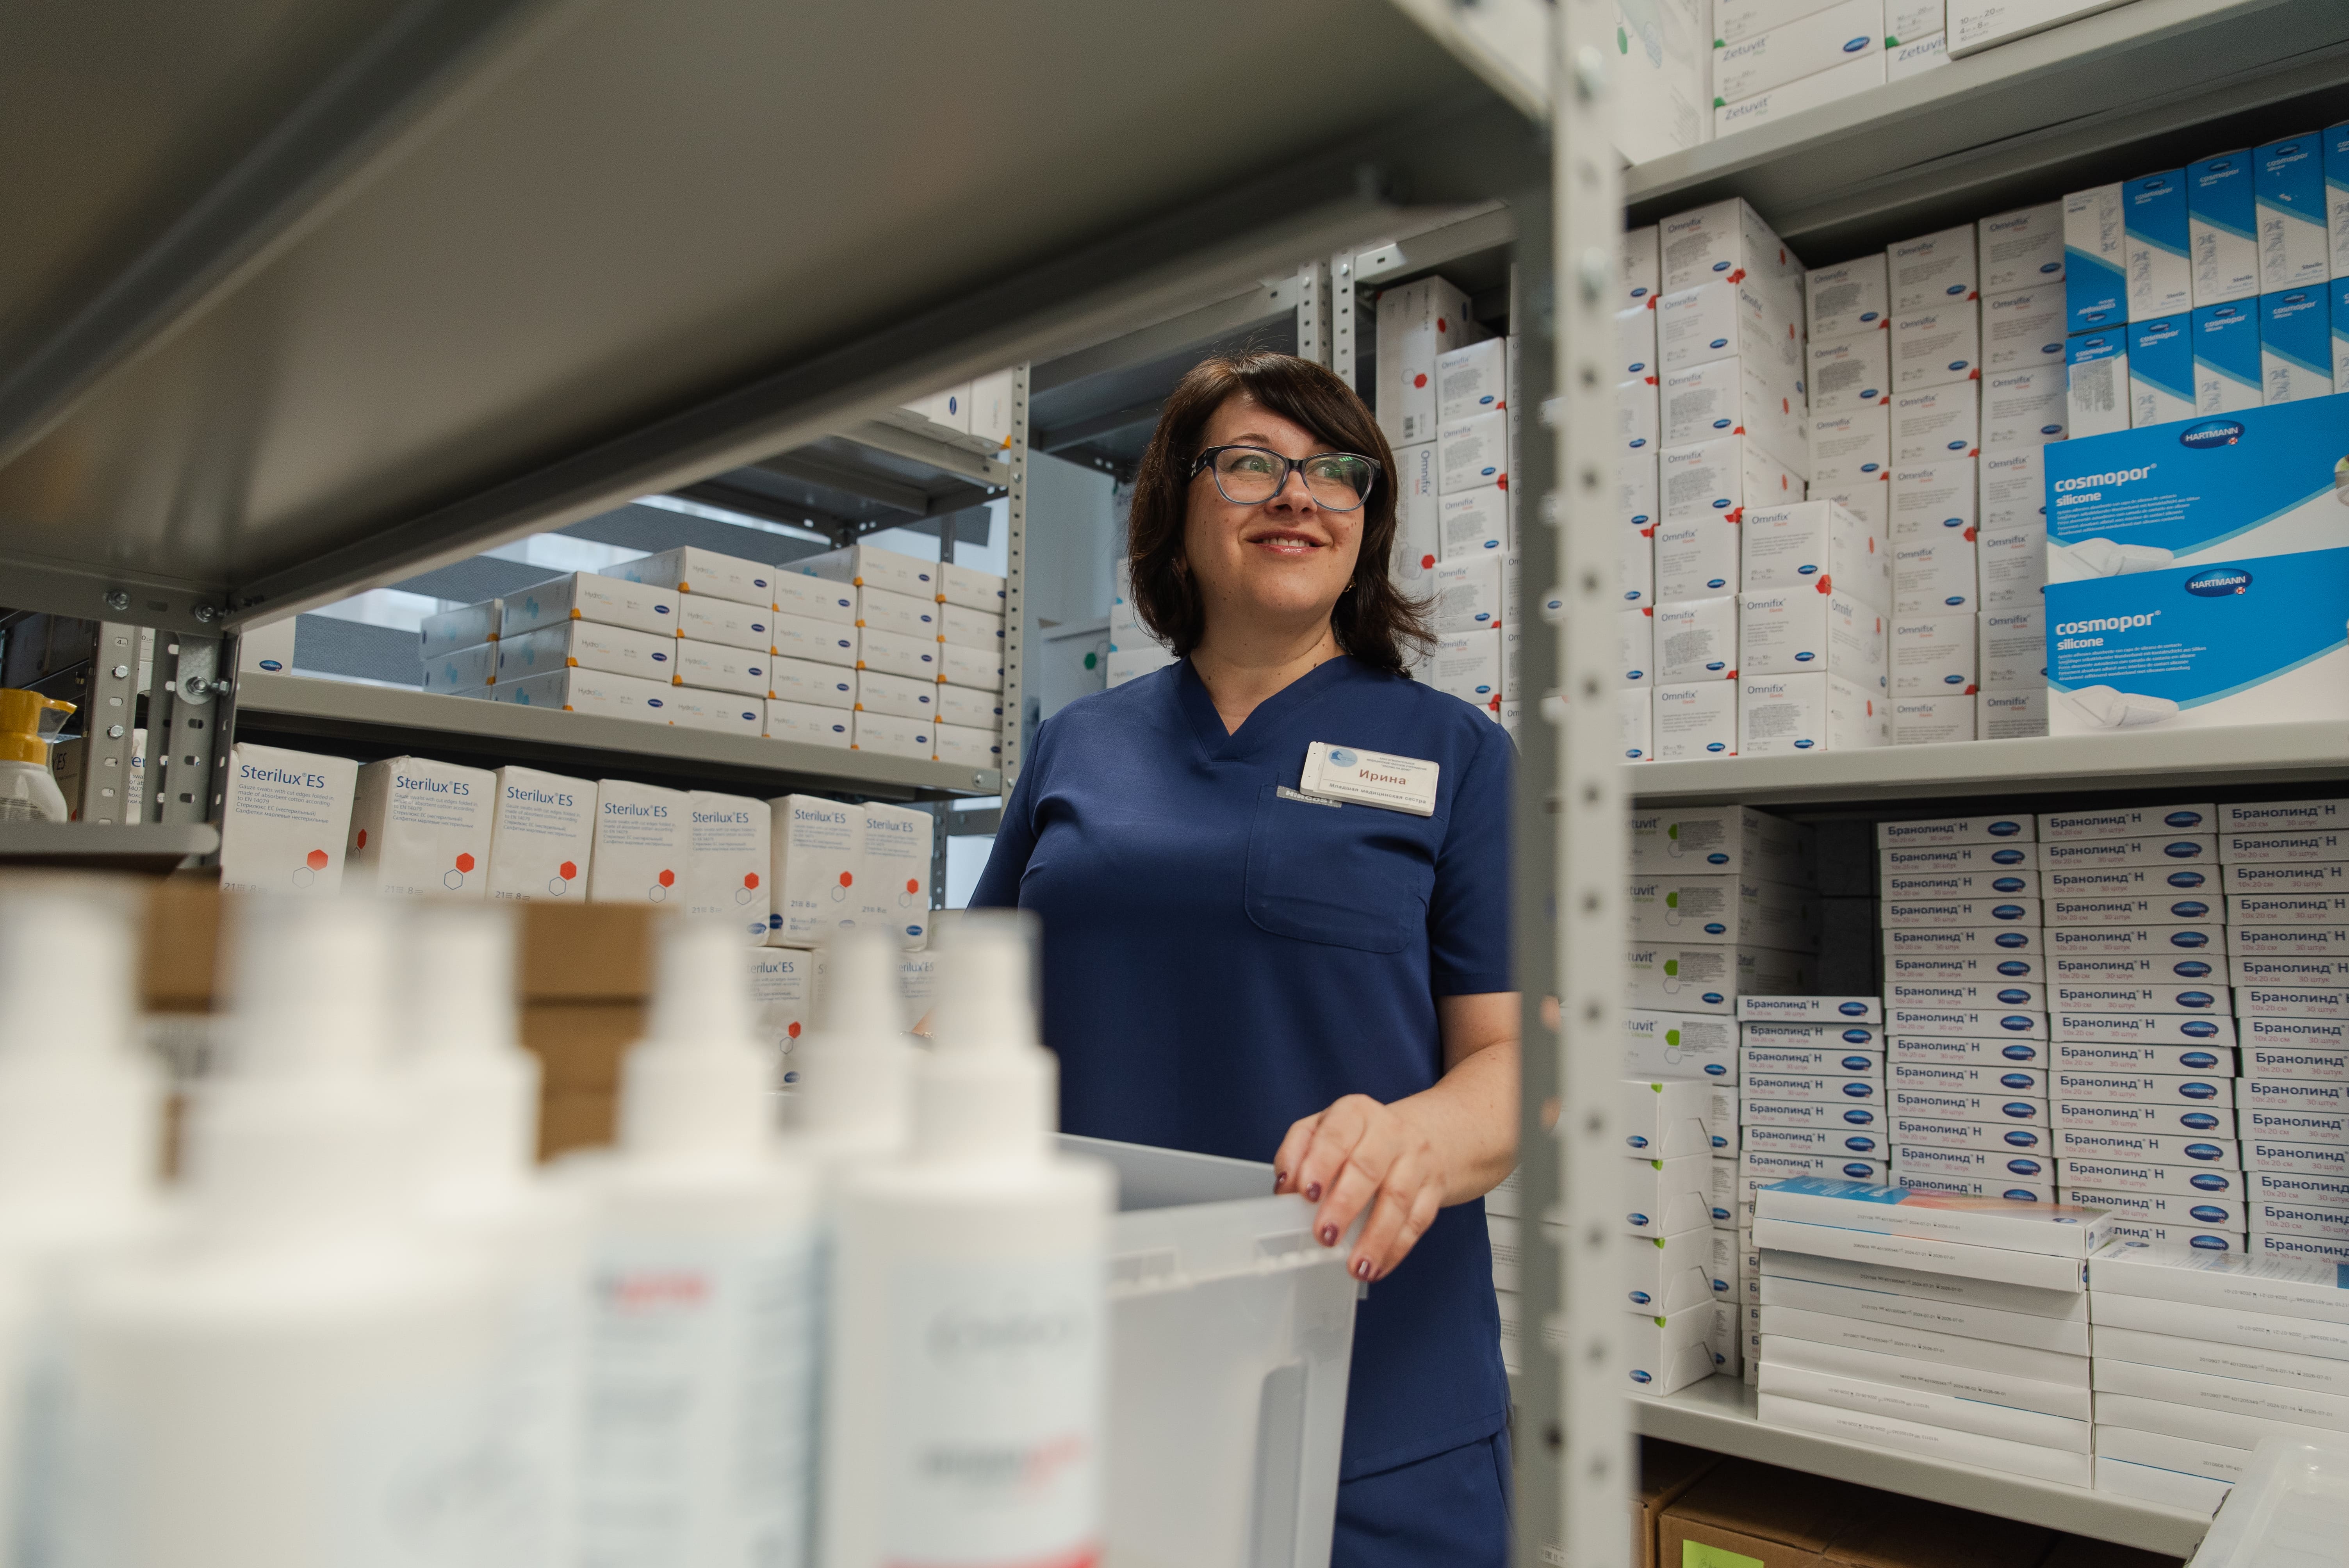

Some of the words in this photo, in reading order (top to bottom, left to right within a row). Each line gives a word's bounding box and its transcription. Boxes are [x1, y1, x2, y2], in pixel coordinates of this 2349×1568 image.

[2186, 427, 2239, 442] HARTMANN
[2056, 492, 2101, 507] silicone
[2190, 576, 2246, 589] HARTMANN
[2057, 637, 2104, 651] silicone
[307, 774, 325, 788] ES
[1359, 769, 1406, 785] Ирина
[453, 782, 469, 795] ES
[1329, 783, 1358, 792] Младшая
[1361, 789, 1403, 800] медицинская
[306, 798, 330, 807] according
[559, 794, 573, 806] ES
[1286, 790, 1333, 804] HIRCOST
[237, 802, 266, 810] Стерилюкс
[276, 806, 316, 816] (нестерильный)
[654, 805, 668, 818] ES
[292, 815, 329, 823] нестерильные
[736, 812, 749, 823] ES
[834, 813, 846, 823] ES
